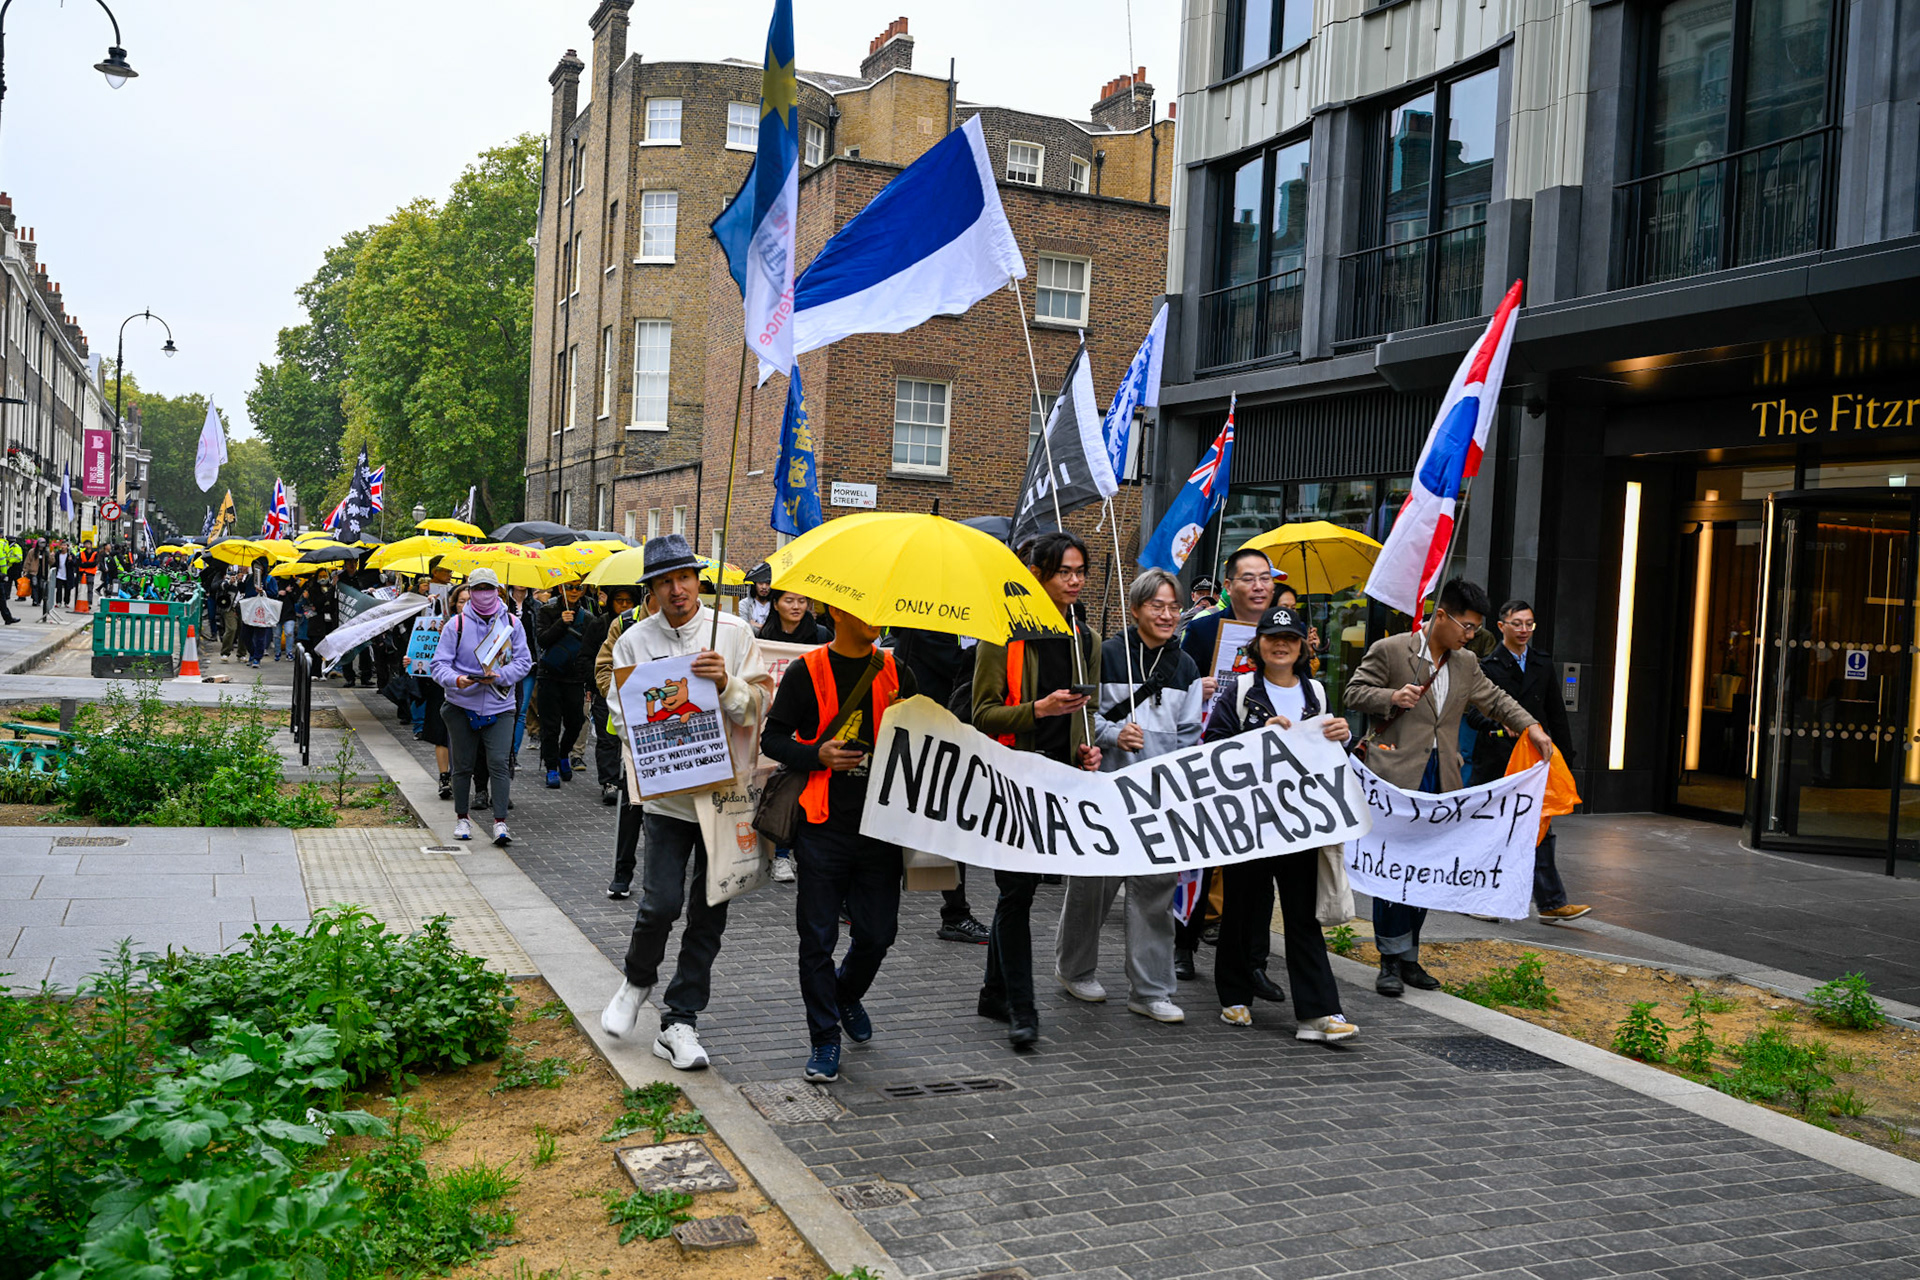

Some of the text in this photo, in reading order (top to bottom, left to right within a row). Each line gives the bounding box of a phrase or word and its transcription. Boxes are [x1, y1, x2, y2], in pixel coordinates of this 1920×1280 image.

[1751, 393, 1920, 437] The Fitzr
[89, 472, 97, 483] THIS
[97, 451, 105, 484] BLOOMSBURY
[833, 488, 869, 497] MORWELL
[833, 496, 859, 505] STREET
[804, 573, 866, 601] BUT I'M NOT THE
[895, 598, 971, 621] ONLY ONE
[639, 742, 724, 766] CCP IS WATCHING YOU
[641, 767, 658, 779] STOP
[659, 765, 671, 776] THE
[695, 753, 726, 767] EMBASSY
[1114, 730, 1310, 815] MEGA
[878, 726, 1120, 856] NO CHINA'S
[1130, 764, 1359, 865] EMBASSY
[1351, 838, 1503, 902] Independent
